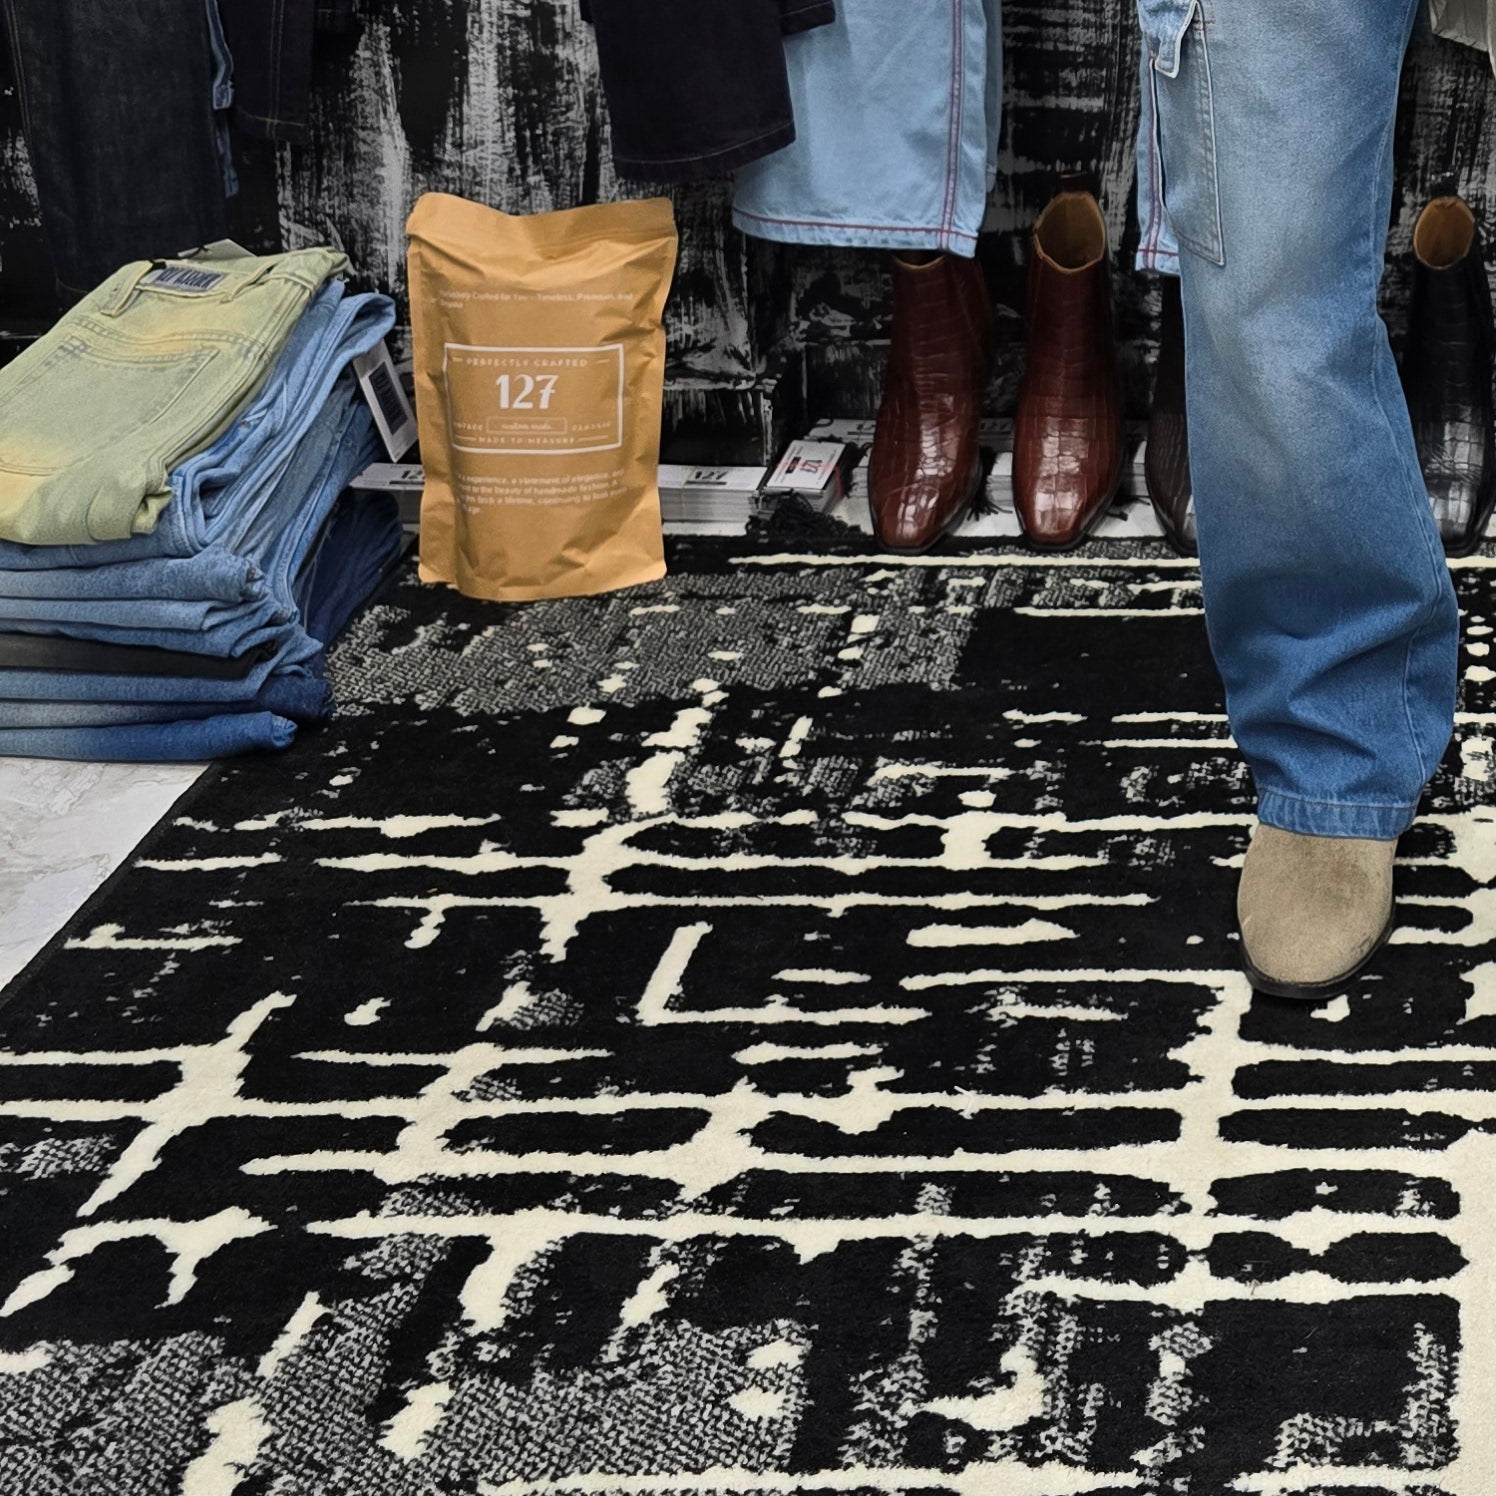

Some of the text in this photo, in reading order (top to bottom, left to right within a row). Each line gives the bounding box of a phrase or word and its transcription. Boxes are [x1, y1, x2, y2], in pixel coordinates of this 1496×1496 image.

[466, 357, 588, 368] PERFECTLY CRAFTED
[495, 373, 560, 410] 127
[693, 470, 728, 481] 127
